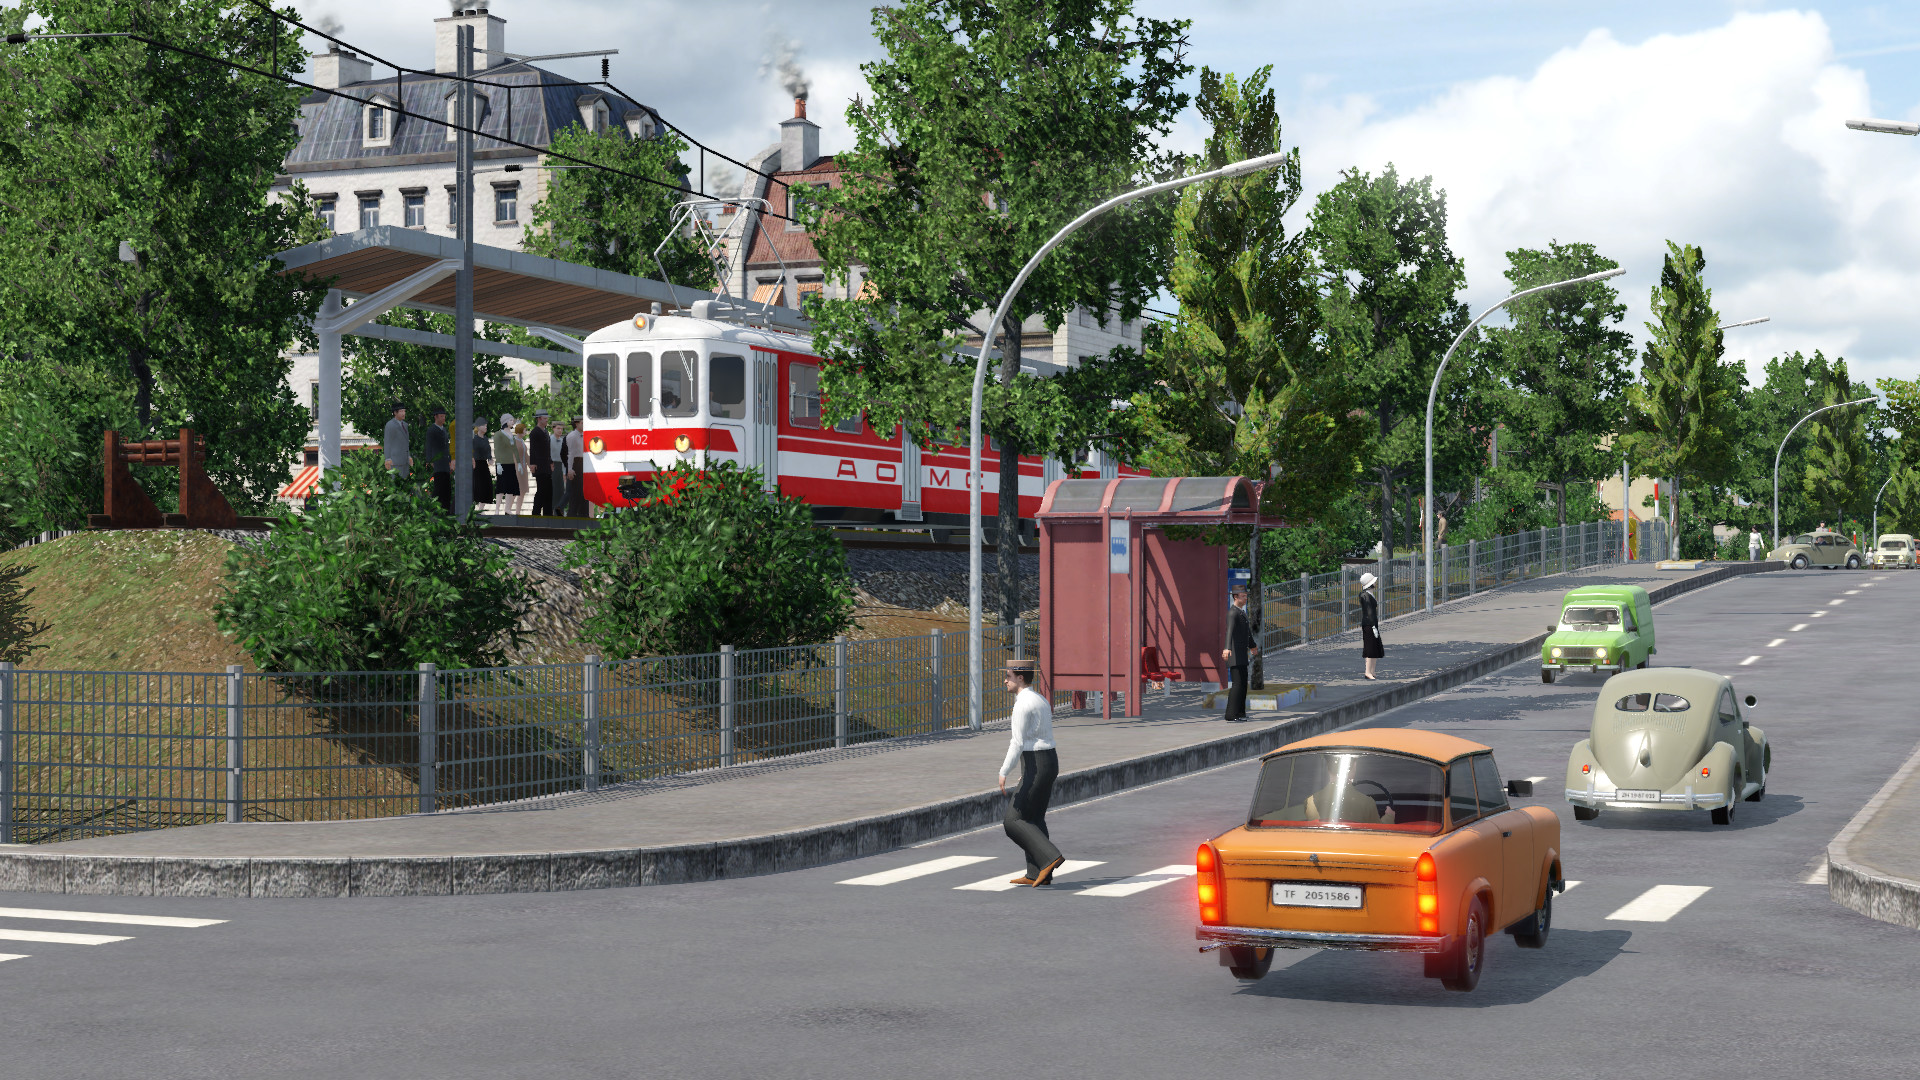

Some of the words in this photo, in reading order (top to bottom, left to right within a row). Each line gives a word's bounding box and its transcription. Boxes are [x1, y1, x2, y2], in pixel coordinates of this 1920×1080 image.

[631, 434, 648, 446] 102
[1284, 889, 1296, 899] TF
[1305, 890, 1350, 901] 2051586
